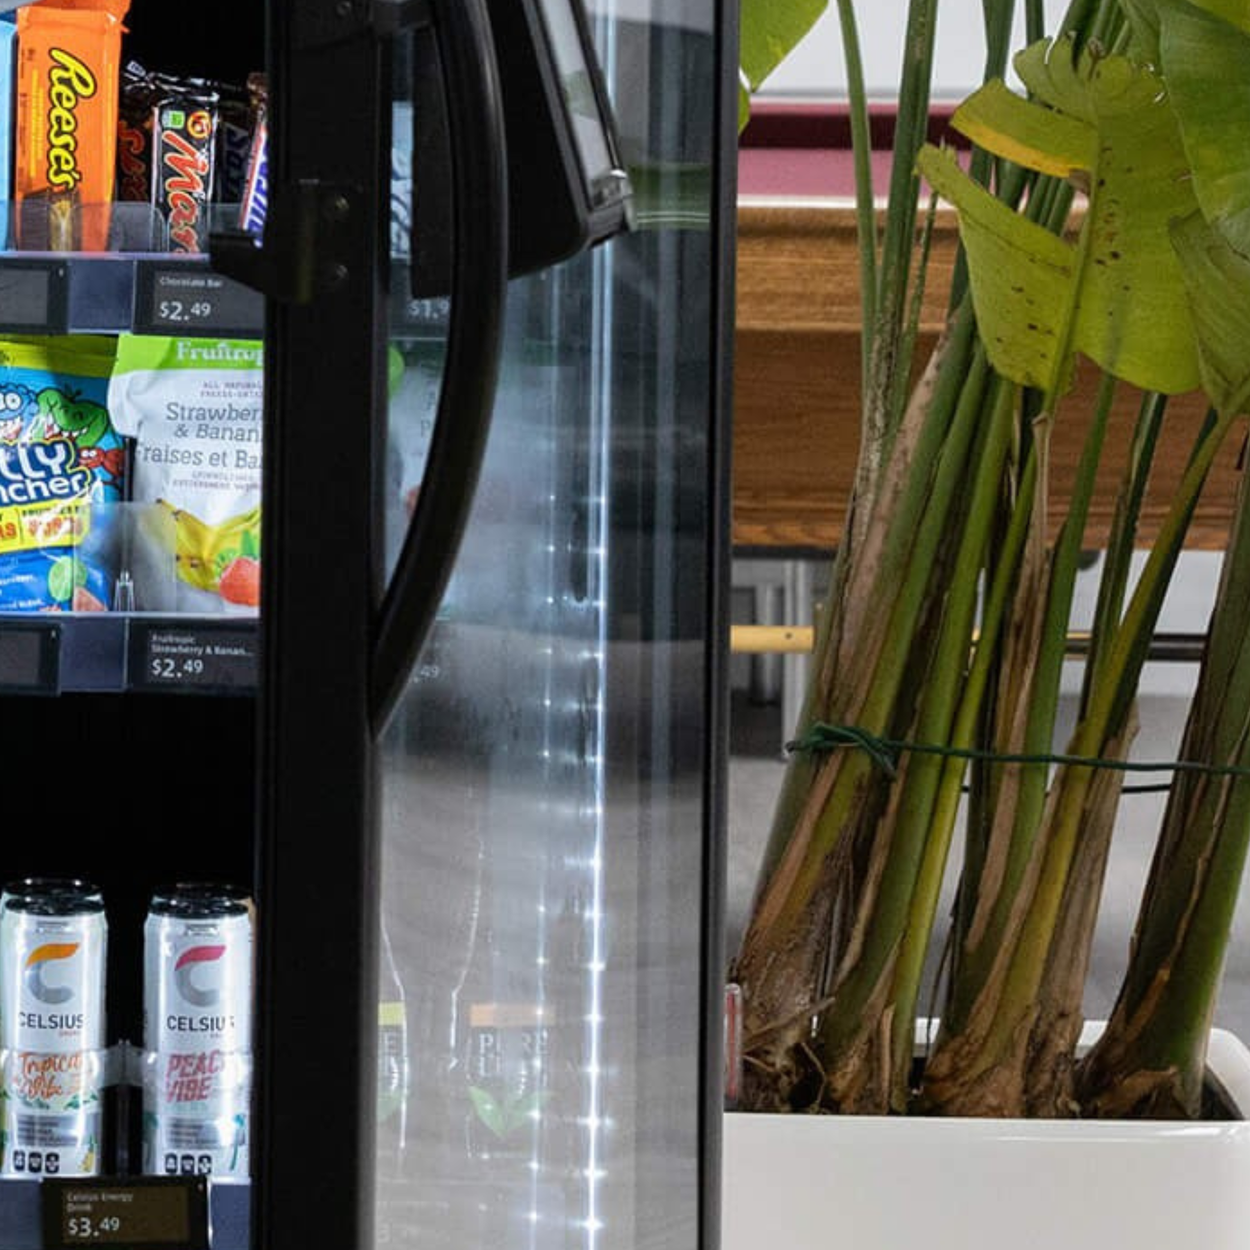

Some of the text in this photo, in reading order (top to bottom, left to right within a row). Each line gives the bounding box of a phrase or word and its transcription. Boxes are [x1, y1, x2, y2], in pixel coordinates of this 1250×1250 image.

[49, 49, 98, 190] Reese's
[161, 130, 209, 252] Mar
[159, 301, 211, 321] $2.49
[166, 402, 260, 422] Strawber
[174, 423, 261, 443] & Banan
[209, 450, 228, 468] et
[152, 659, 204, 678] $2.49
[18, 1013, 84, 1030] CELSIUS
[17, 1051, 88, 1081] Tropica
[166, 1050, 225, 1078] PEAC
[165, 1076, 213, 1102] VIBE
[68, 1216, 120, 1238] $3.49
